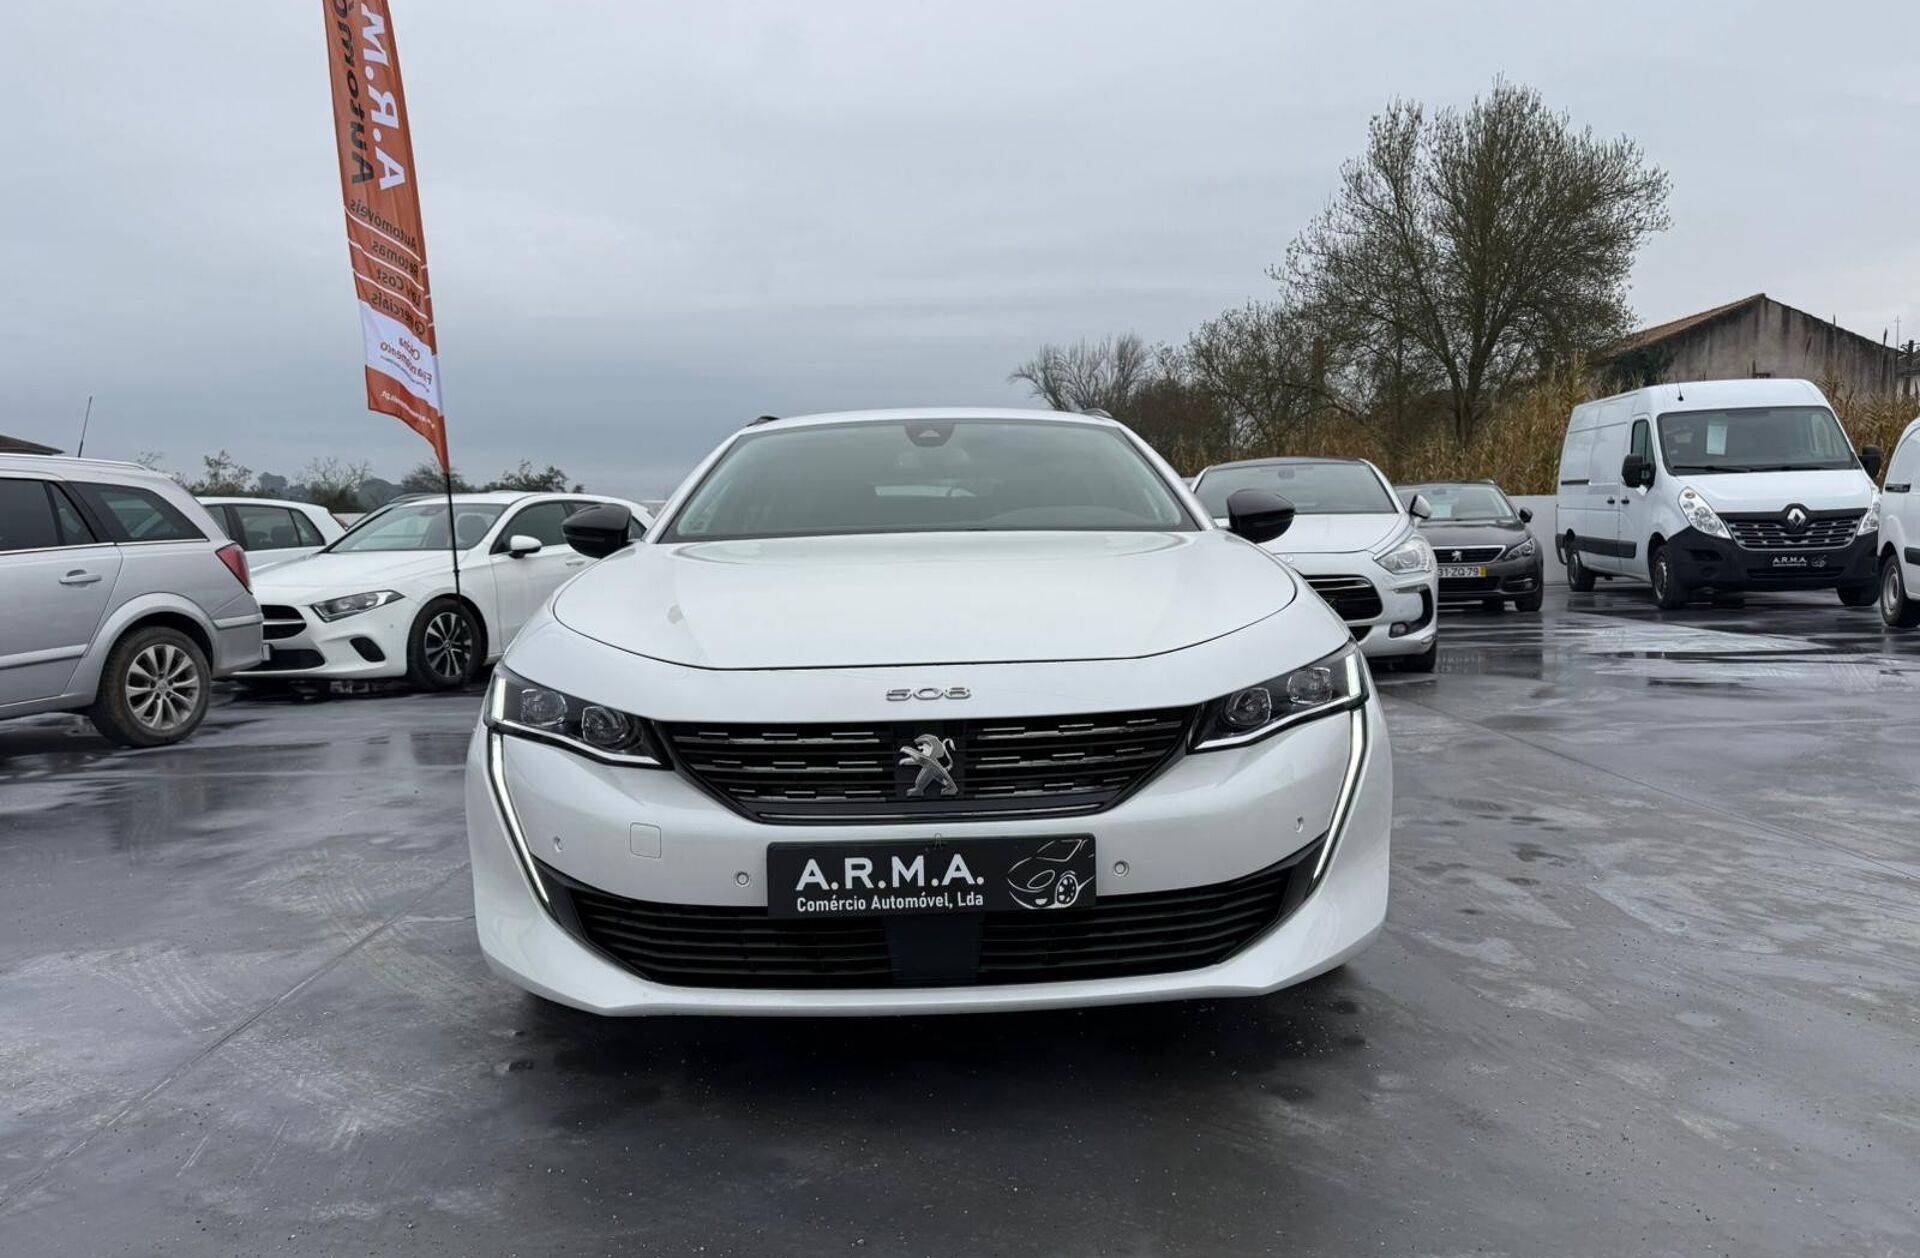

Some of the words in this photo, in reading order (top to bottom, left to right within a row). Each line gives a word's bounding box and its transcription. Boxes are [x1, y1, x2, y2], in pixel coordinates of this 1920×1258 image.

[886, 687, 971, 701] 508
[796, 854, 985, 891] A.R.M.A.
[797, 894, 866, 912] Comércio
[871, 891, 954, 910] Automóvel,
[957, 891, 984, 907] Lda
